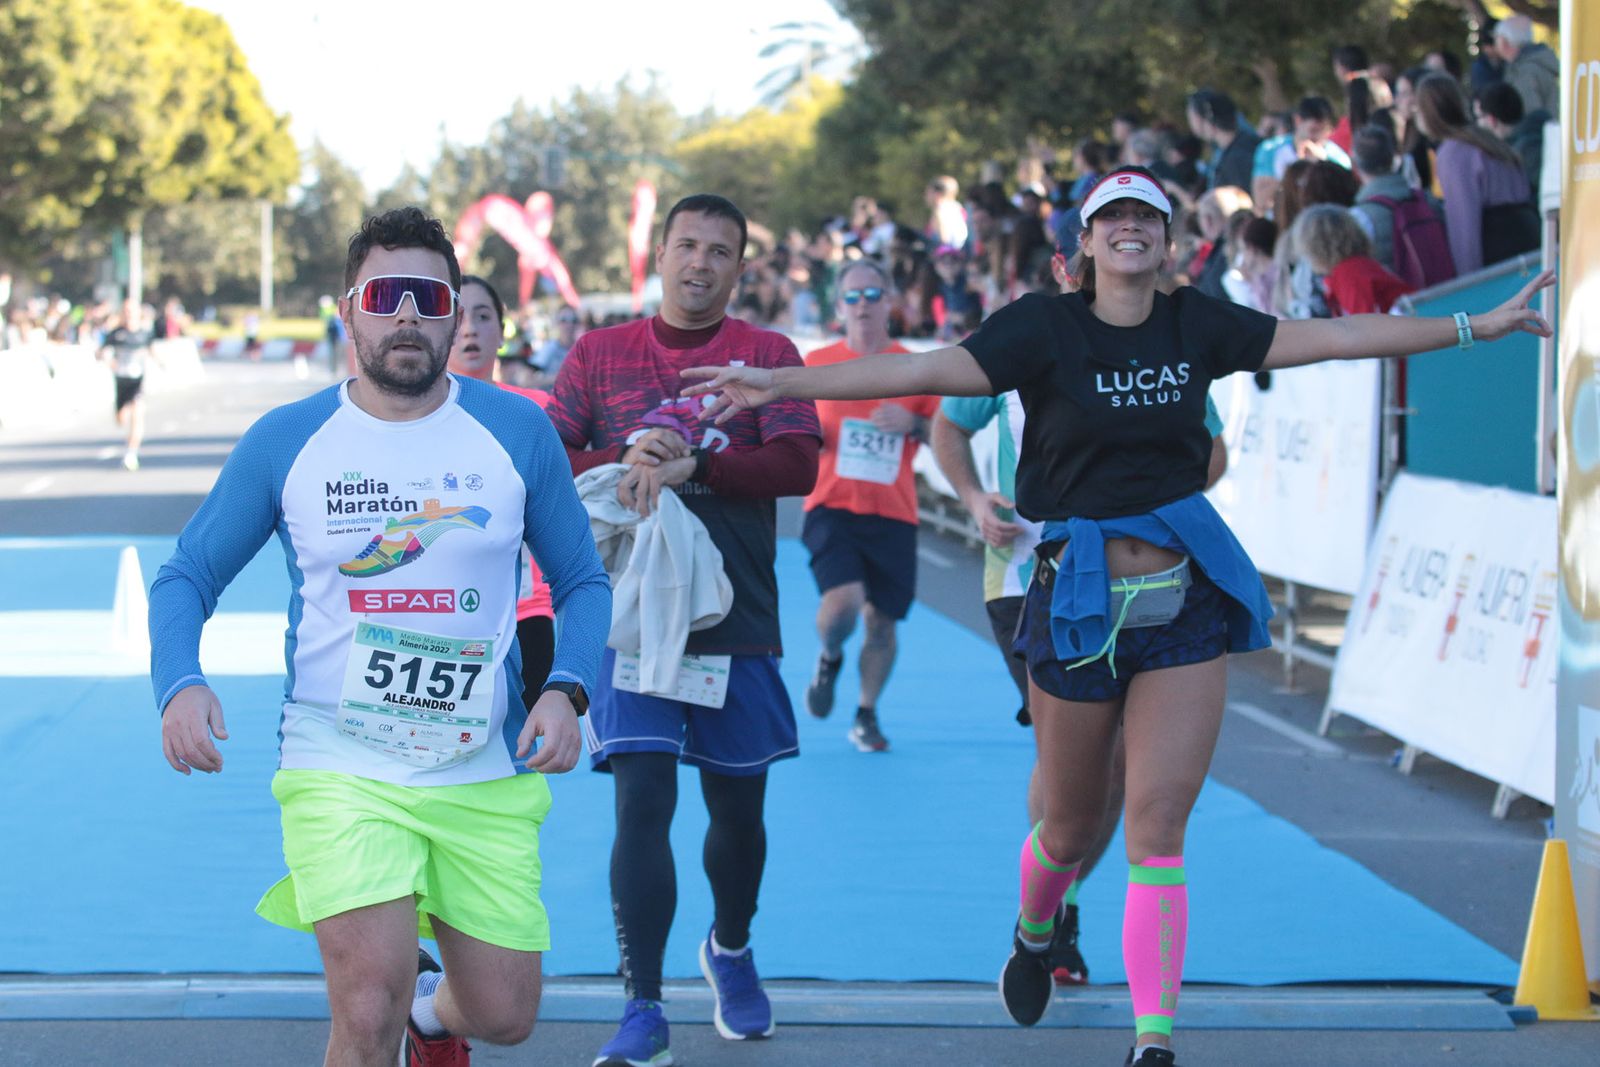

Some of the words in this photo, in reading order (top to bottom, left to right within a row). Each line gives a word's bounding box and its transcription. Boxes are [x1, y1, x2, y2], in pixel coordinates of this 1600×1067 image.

[1096, 362, 1191, 393] LUCAS
[1111, 390, 1181, 407] SALUD
[847, 431, 897, 454] 5211
[343, 471, 362, 481] XXX
[326, 478, 389, 497] Media
[327, 496, 418, 515] Maratón
[327, 516, 382, 527] Internacional
[327, 528, 345, 536] Ciudad
[364, 593, 453, 609] SPAR
[364, 649, 483, 701] 5157
[383, 692, 456, 712] ALEJANDRO
[378, 722, 396, 733] CDX
